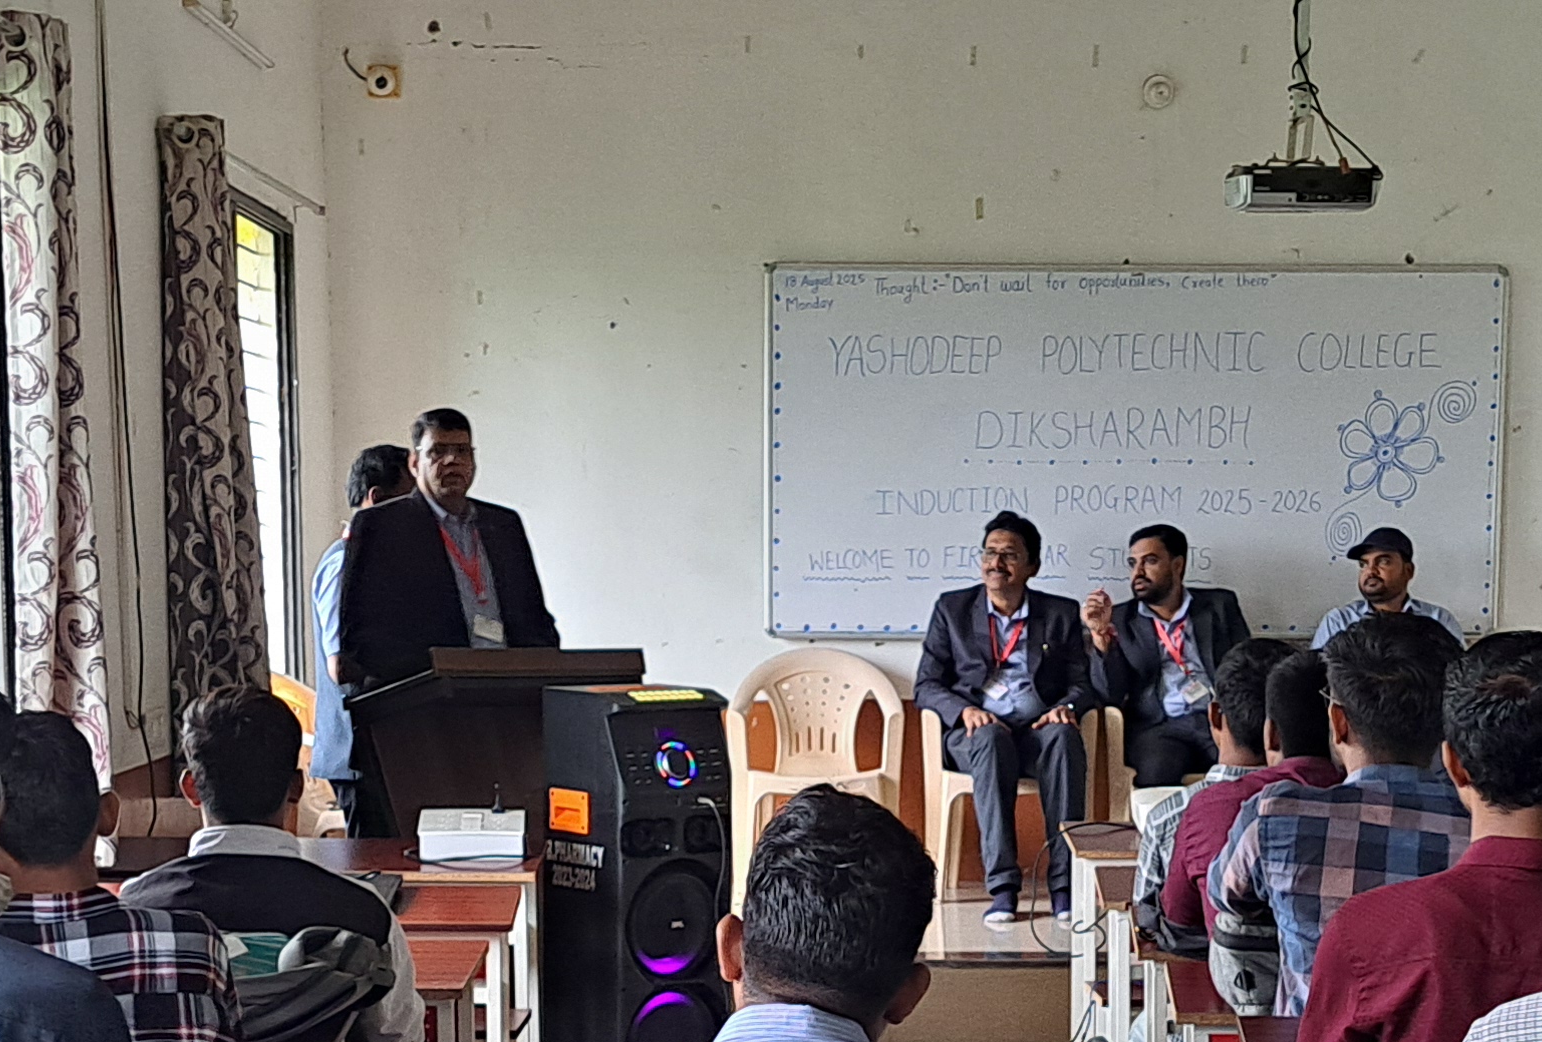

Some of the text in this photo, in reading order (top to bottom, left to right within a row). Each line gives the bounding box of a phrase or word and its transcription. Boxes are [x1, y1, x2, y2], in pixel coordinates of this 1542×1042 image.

[836, 273, 866, 286] 2025
[1000, 273, 1033, 293] wait
[1045, 272, 1067, 291] for
[785, 296, 834, 312] Monday
[828, 331, 1442, 377] YASHODEEP POLYTECHNIC COLLEGE
[975, 405, 1252, 450] DIKSHARAMBH
[875, 484, 1322, 516] INDUCTION PROGRAM 2025-2026
[808, 548, 894, 572] WELCOME
[904, 548, 931, 569] TO
[943, 545, 983, 569] FIR
